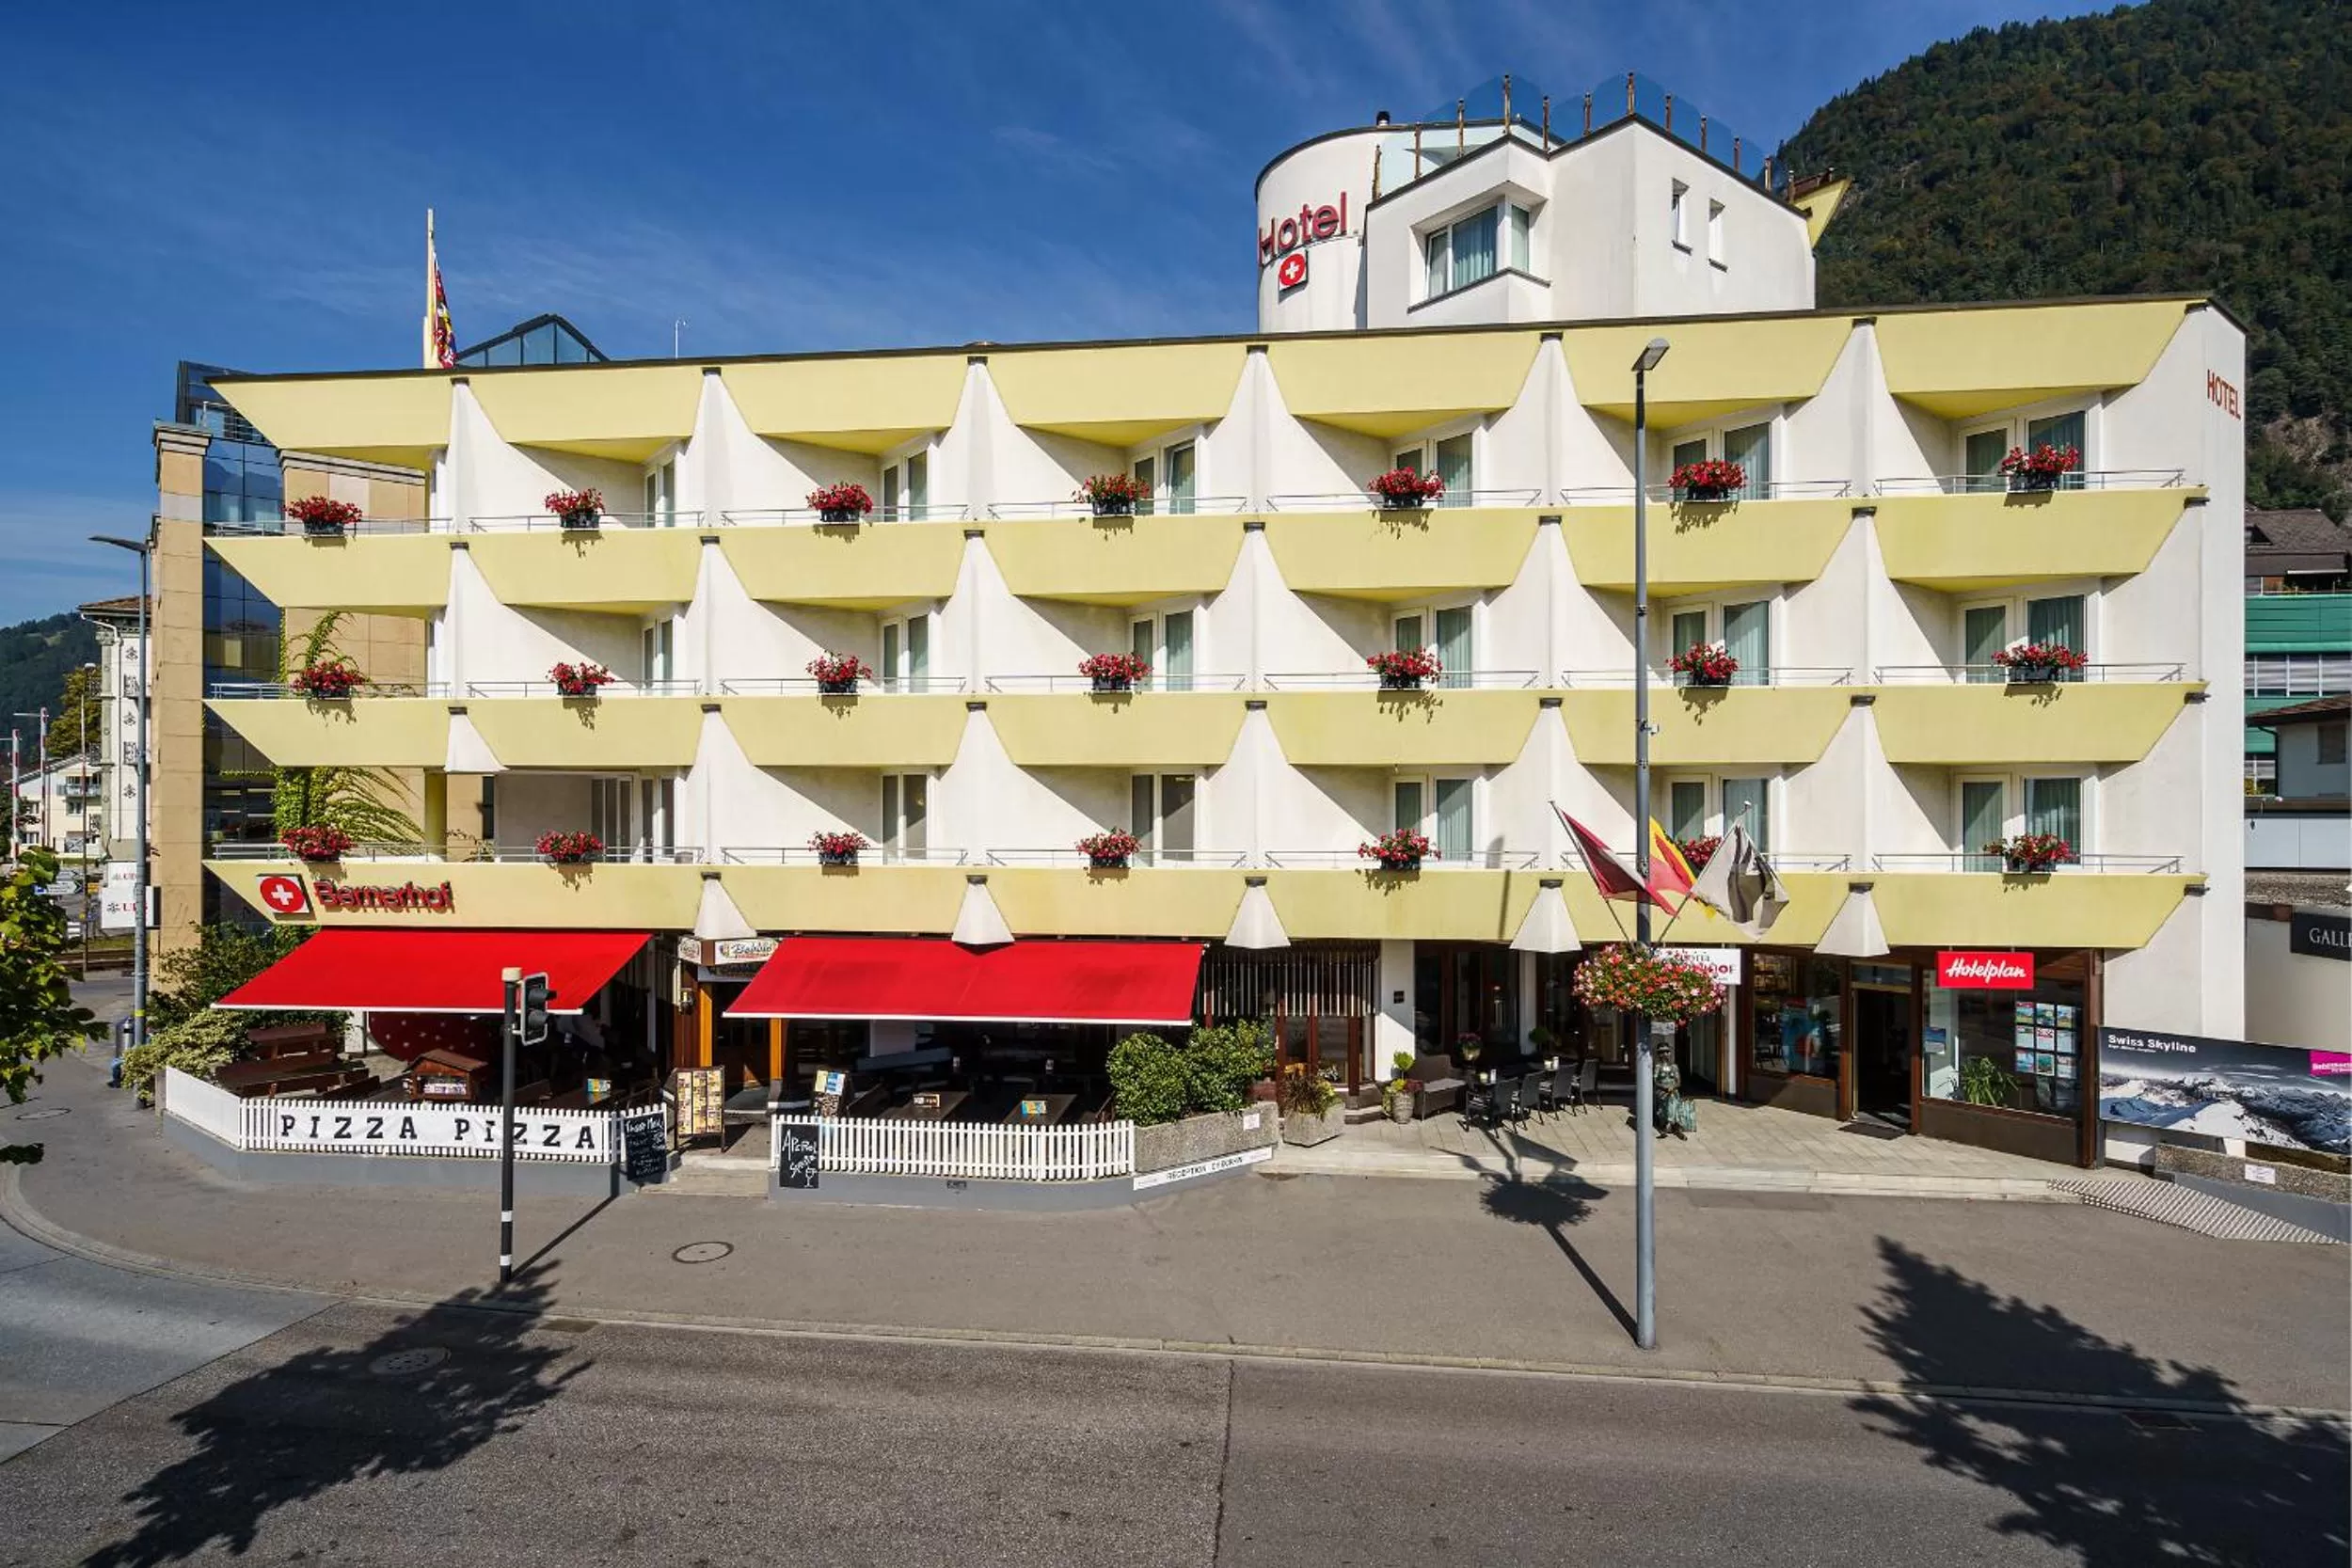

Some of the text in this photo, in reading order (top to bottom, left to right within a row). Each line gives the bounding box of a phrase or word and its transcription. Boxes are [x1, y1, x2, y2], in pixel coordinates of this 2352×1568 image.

[1257, 191, 1347, 269] Hotel
[2206, 368, 2242, 421] HOTEL
[313, 880, 455, 909] Bernerhof
[1945, 957, 2026, 985] Hotelplan
[2107, 1034, 2144, 1047] Swiss
[2147, 1038, 2197, 1053] Skyline
[280, 1115, 418, 1140] PIZZA
[454, 1117, 596, 1149] PIZZA
